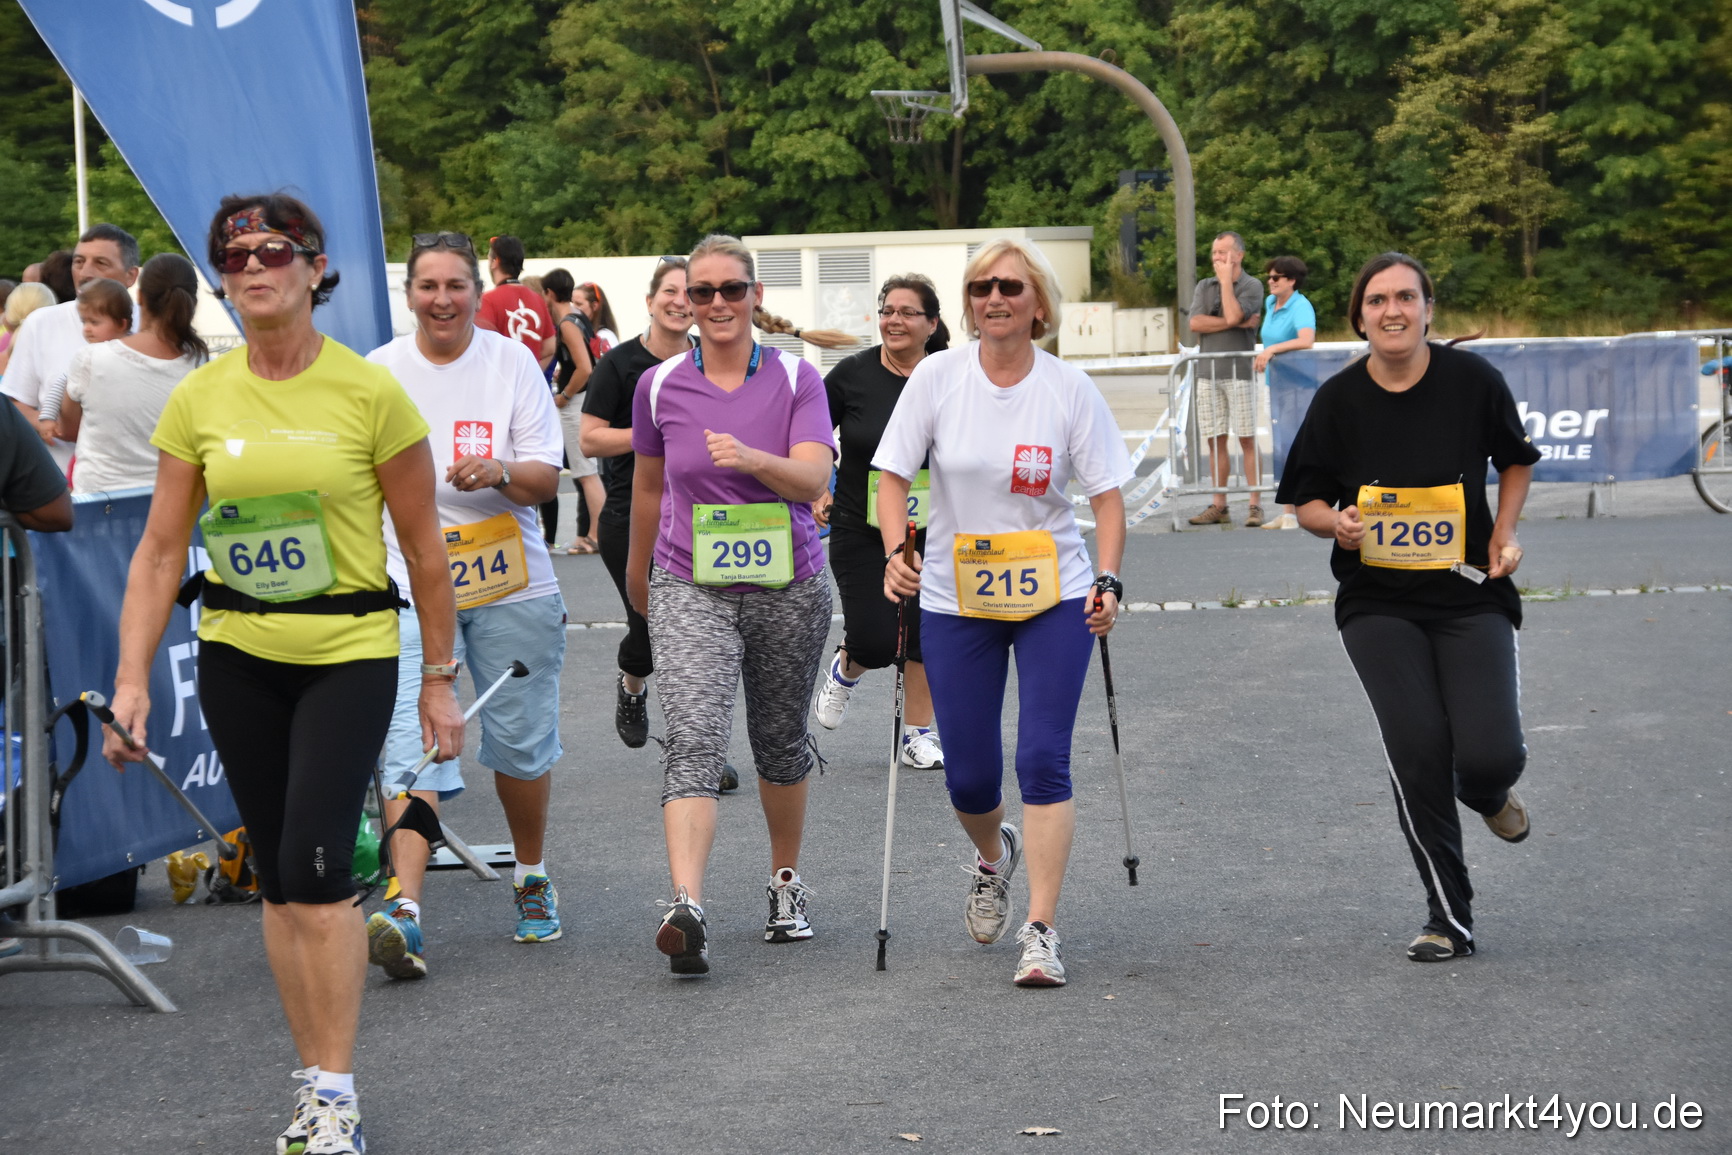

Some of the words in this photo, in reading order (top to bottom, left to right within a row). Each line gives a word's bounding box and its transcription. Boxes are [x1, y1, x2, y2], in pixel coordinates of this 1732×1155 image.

[1013, 485, 1045, 496] caritas
[1370, 520, 1454, 547] 1269
[229, 536, 306, 576] 646
[712, 539, 772, 568] 299
[450, 549, 508, 588] 214
[975, 568, 1039, 597] 215
[313, 846, 325, 878] adiva
